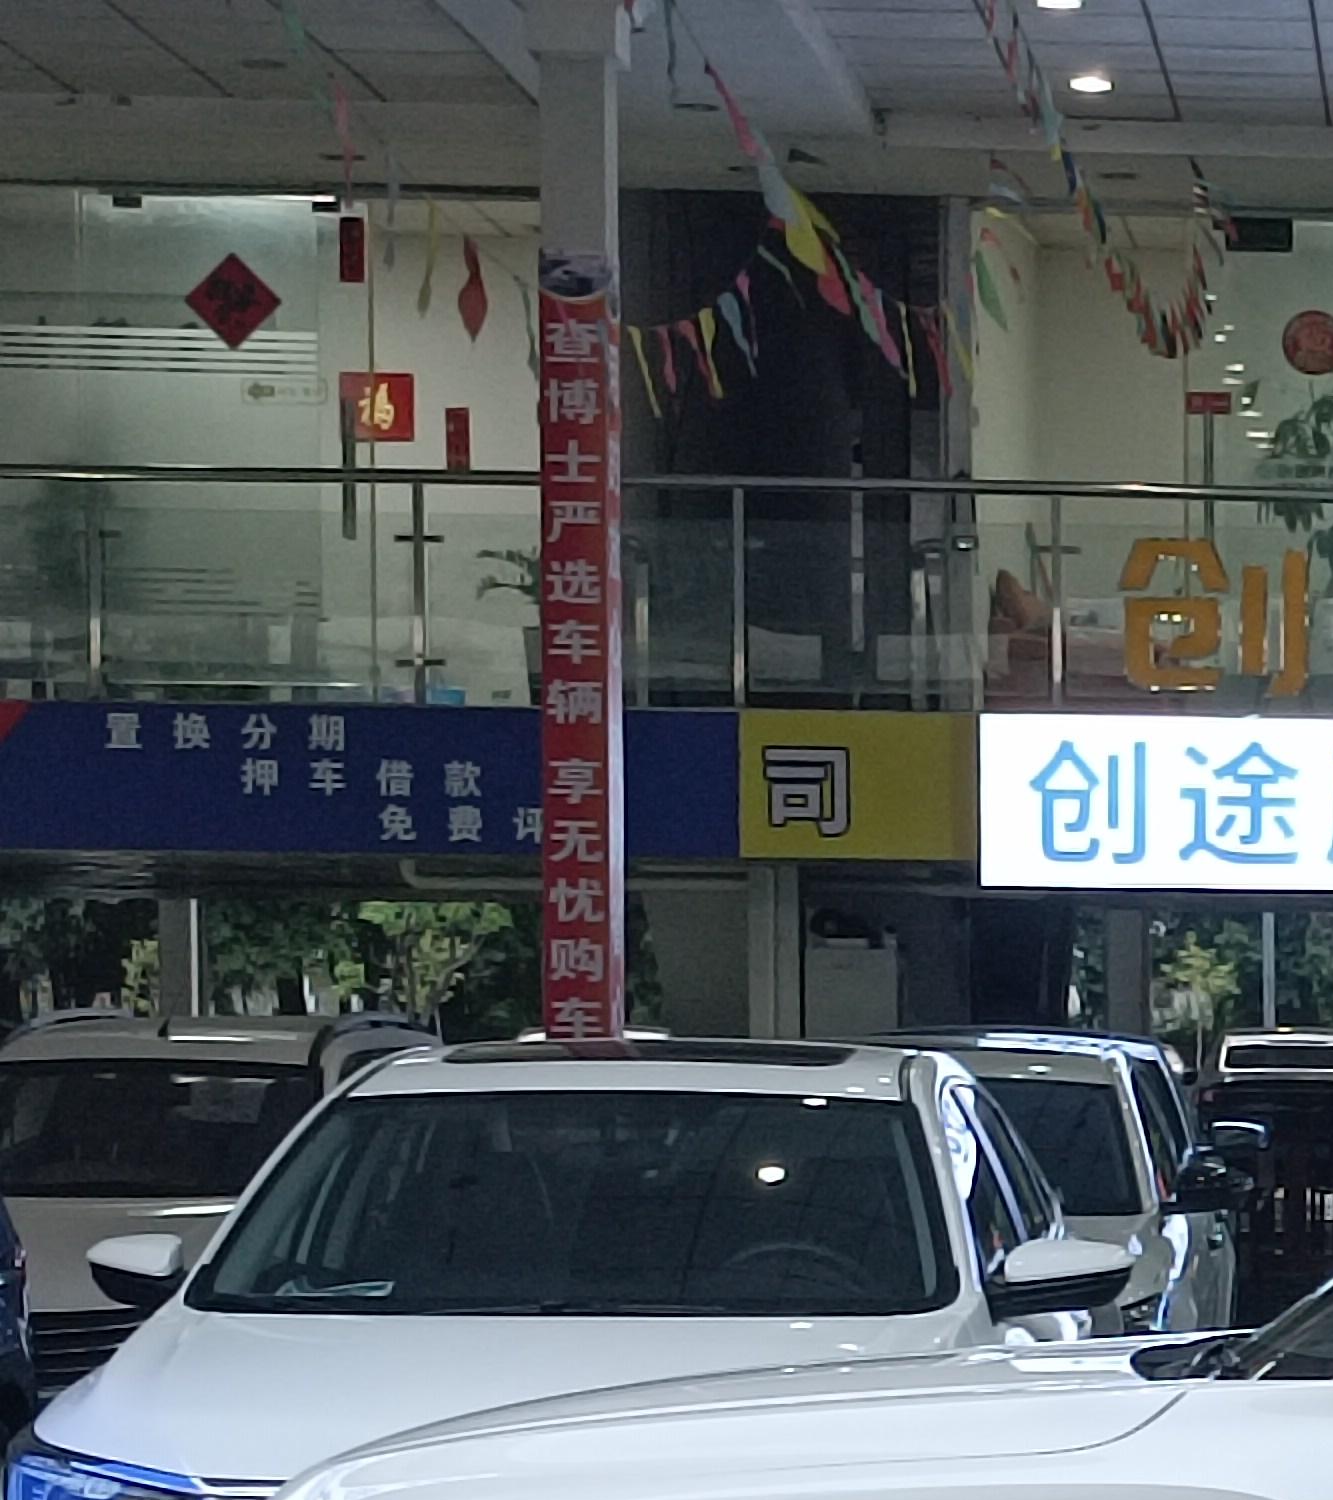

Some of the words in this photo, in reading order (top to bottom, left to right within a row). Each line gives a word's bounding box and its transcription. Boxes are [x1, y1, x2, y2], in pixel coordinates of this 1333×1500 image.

[358, 382, 395, 430] 福
[544, 318, 603, 726] 查博士严选车辆
[104, 712, 346, 752] 置换分期
[240, 758, 482, 797] 押车借款
[762, 746, 850, 837] 司
[548, 757, 606, 1038] 享无忧购车
